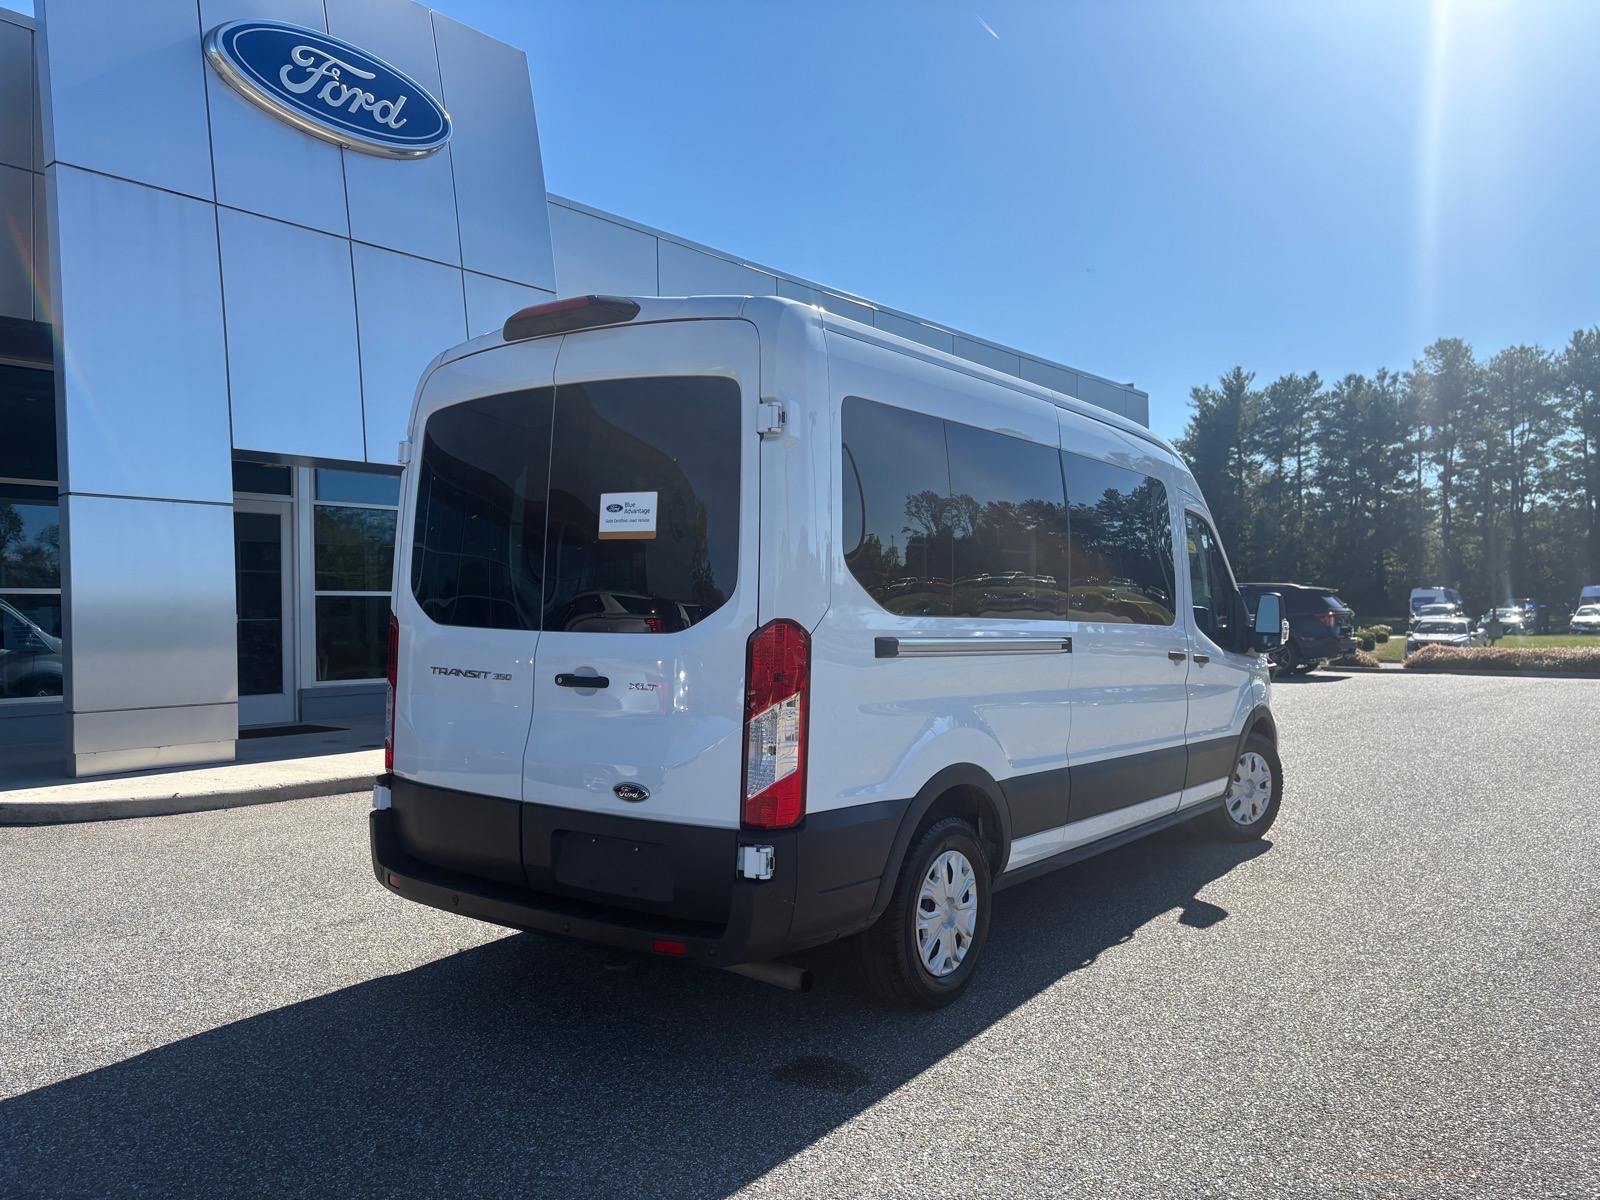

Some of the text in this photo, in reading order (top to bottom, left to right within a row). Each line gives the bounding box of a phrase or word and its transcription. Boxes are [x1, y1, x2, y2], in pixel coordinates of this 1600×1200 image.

[279, 45, 407, 129] Ford
[430, 666, 492, 679] TRANSIT
[629, 682, 658, 691] XLT
[618, 786, 639, 799] Ford
